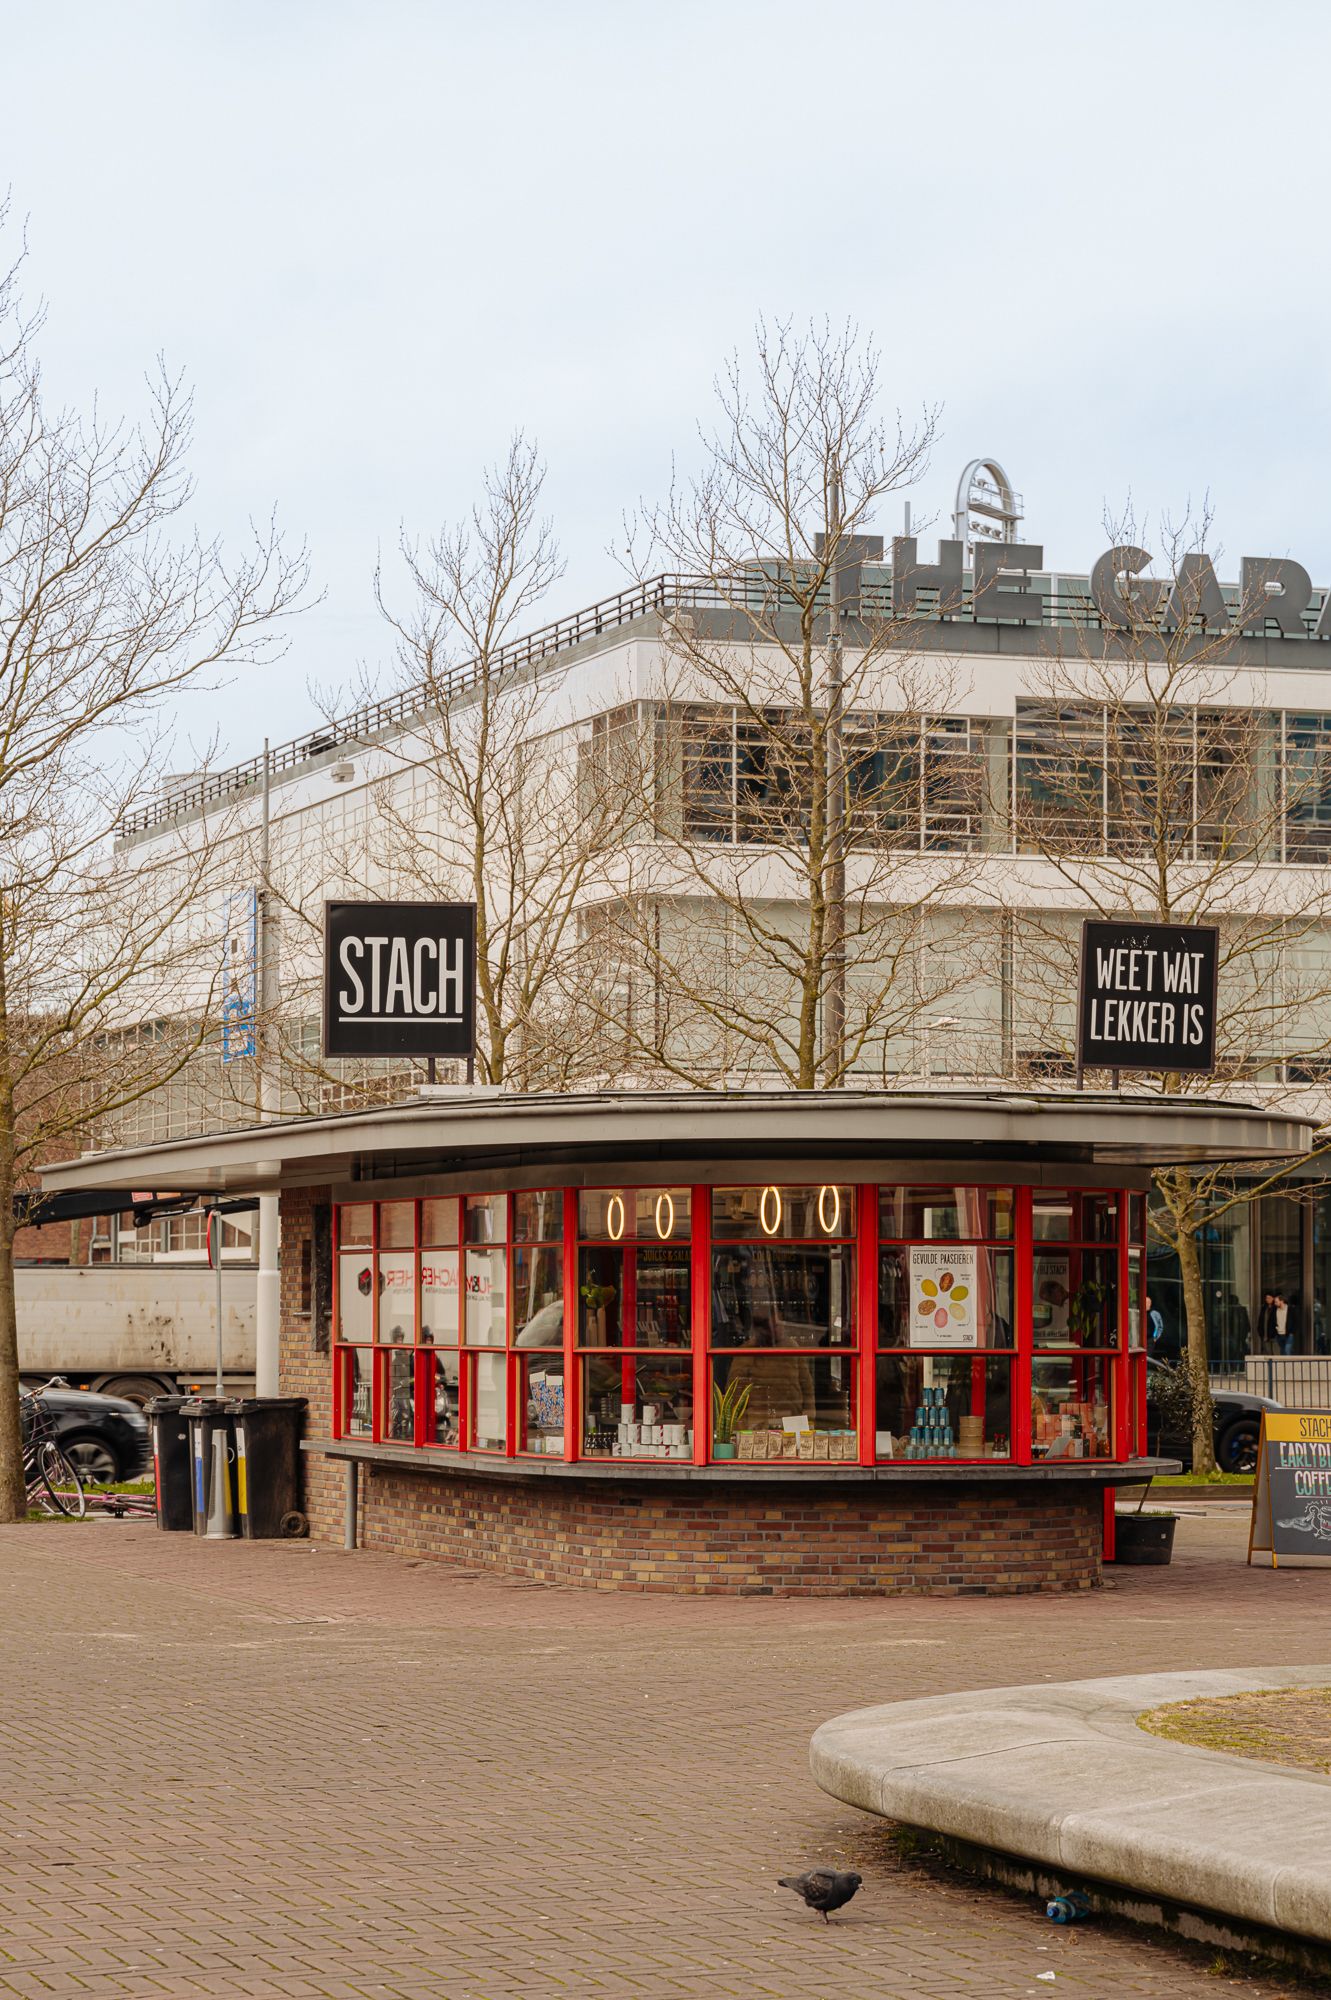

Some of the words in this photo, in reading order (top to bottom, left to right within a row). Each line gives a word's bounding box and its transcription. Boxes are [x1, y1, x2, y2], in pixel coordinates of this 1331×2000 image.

[814, 532, 1043, 620] THE
[1090, 545, 1331, 635] GAR
[339, 936, 464, 1014] STACH
[1096, 947, 1158, 992] WEET
[1163, 951, 1205, 994] WAT
[1090, 998, 1176, 1044] LEKKER
[1182, 1003, 1205, 1045] IS
[912, 1253, 938, 1265] GEVULDE
[940, 1253, 974, 1265] PAASEIEREN
[1299, 1417, 1331, 1437] STACH
